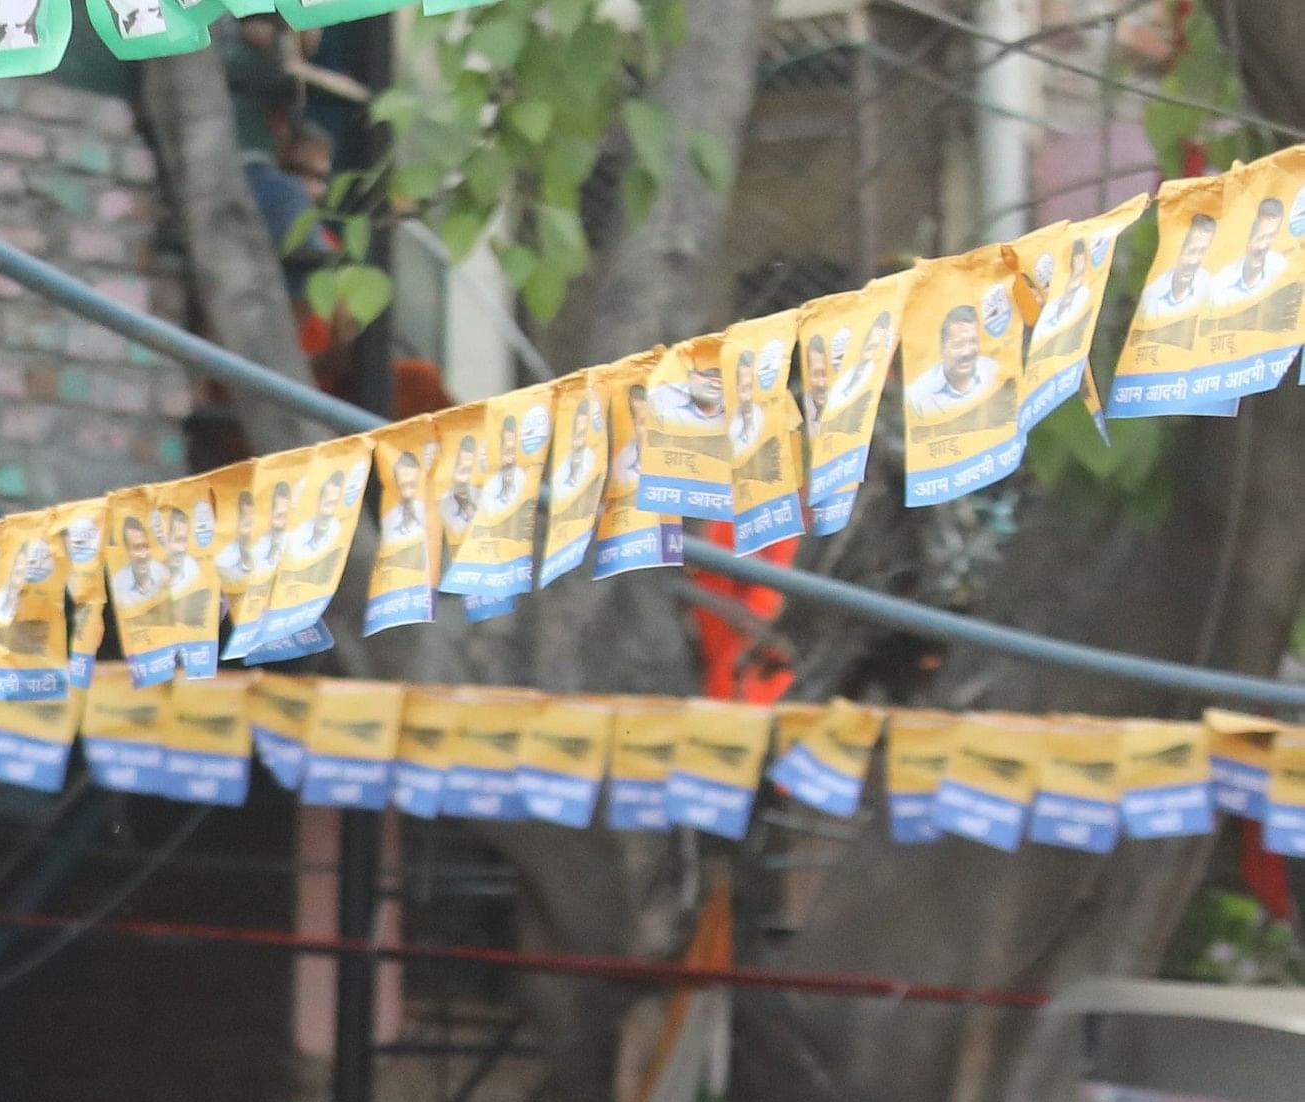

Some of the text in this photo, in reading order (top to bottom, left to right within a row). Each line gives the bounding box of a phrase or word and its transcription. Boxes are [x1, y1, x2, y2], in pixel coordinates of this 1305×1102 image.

[1116, 377, 1188, 404] आम आदमी
[1192, 374, 1222, 395] आम
[1224, 358, 1266, 389] आदमी
[913, 476, 950, 498] आम
[953, 454, 996, 489] आदमी
[646, 485, 682, 505] आम
